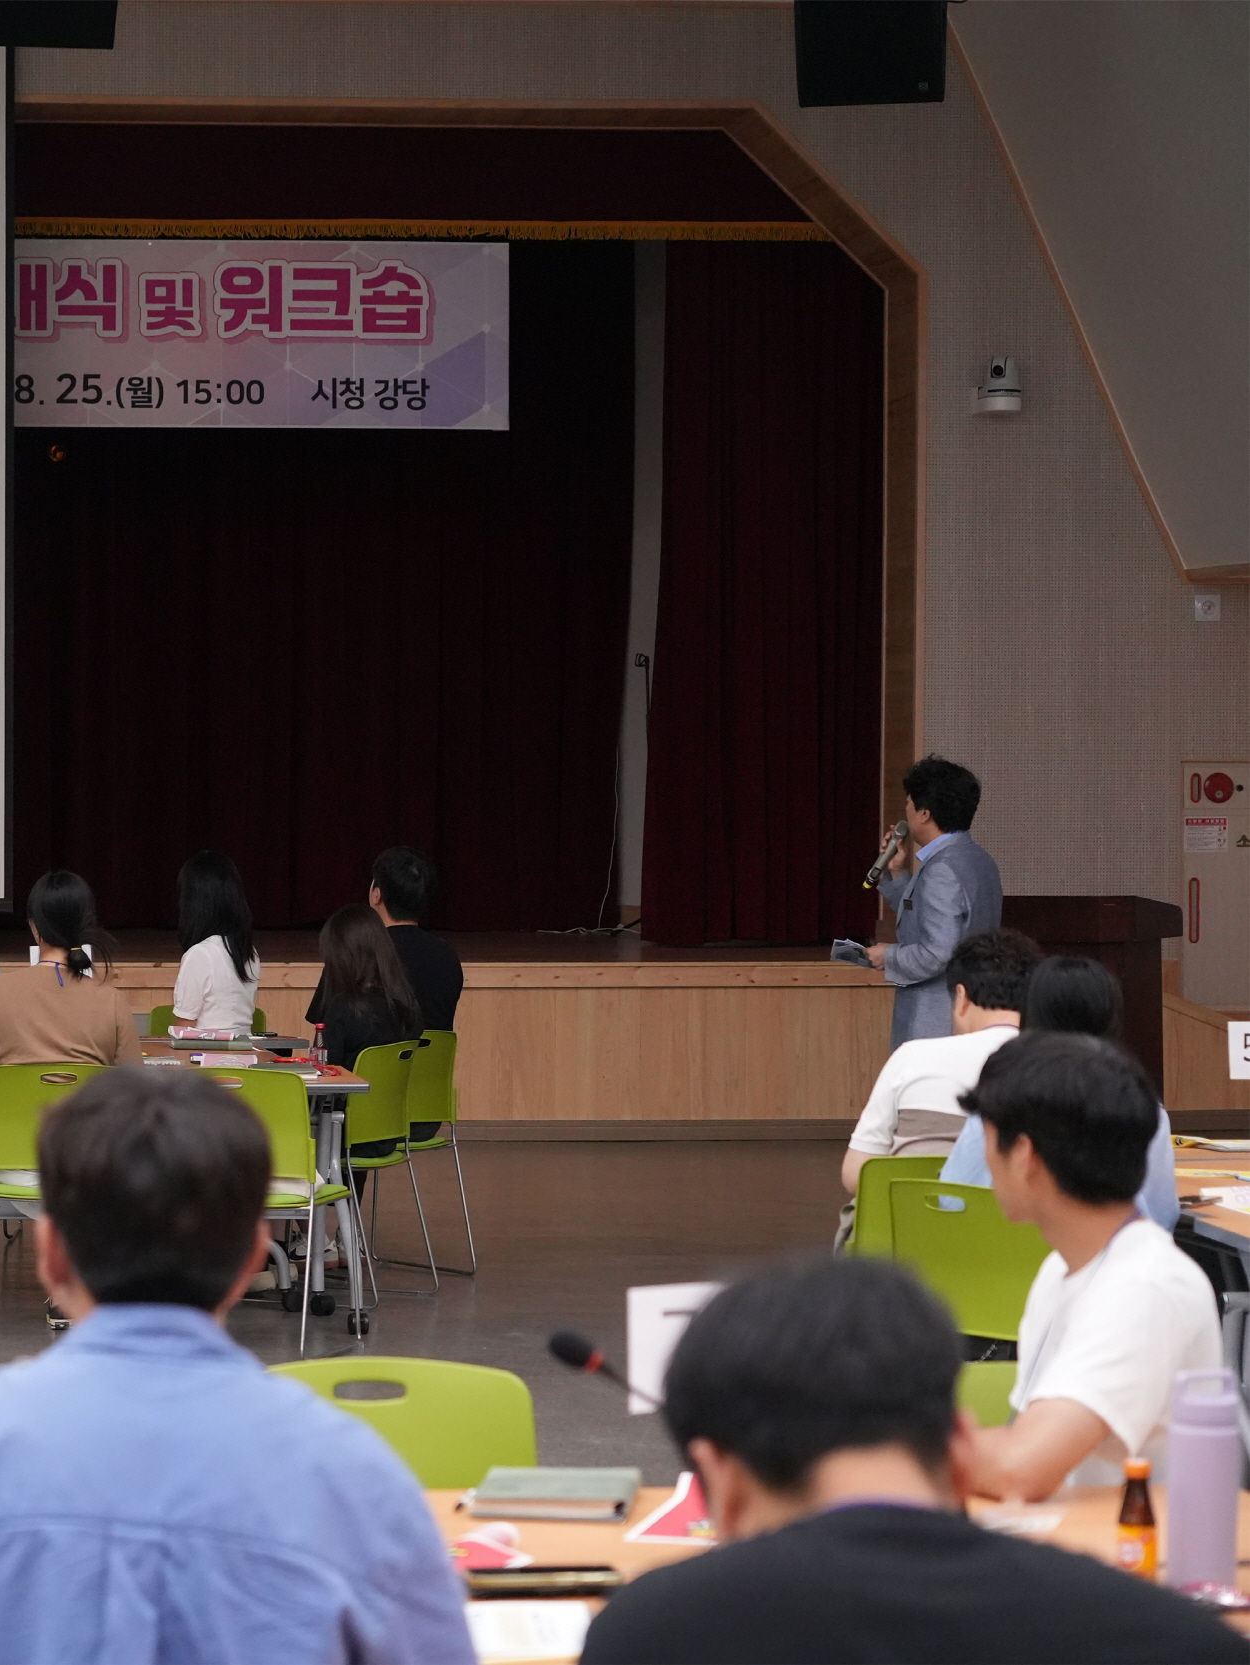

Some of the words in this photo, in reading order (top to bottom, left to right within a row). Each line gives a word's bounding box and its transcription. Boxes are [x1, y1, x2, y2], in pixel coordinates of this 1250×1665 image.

[144, 277, 195, 331] 및
[219, 264, 425, 335] 워크숍
[175, 378, 266, 406] 15:00
[310, 376, 365, 411] 시청
[373, 377, 431, 412] 강당
